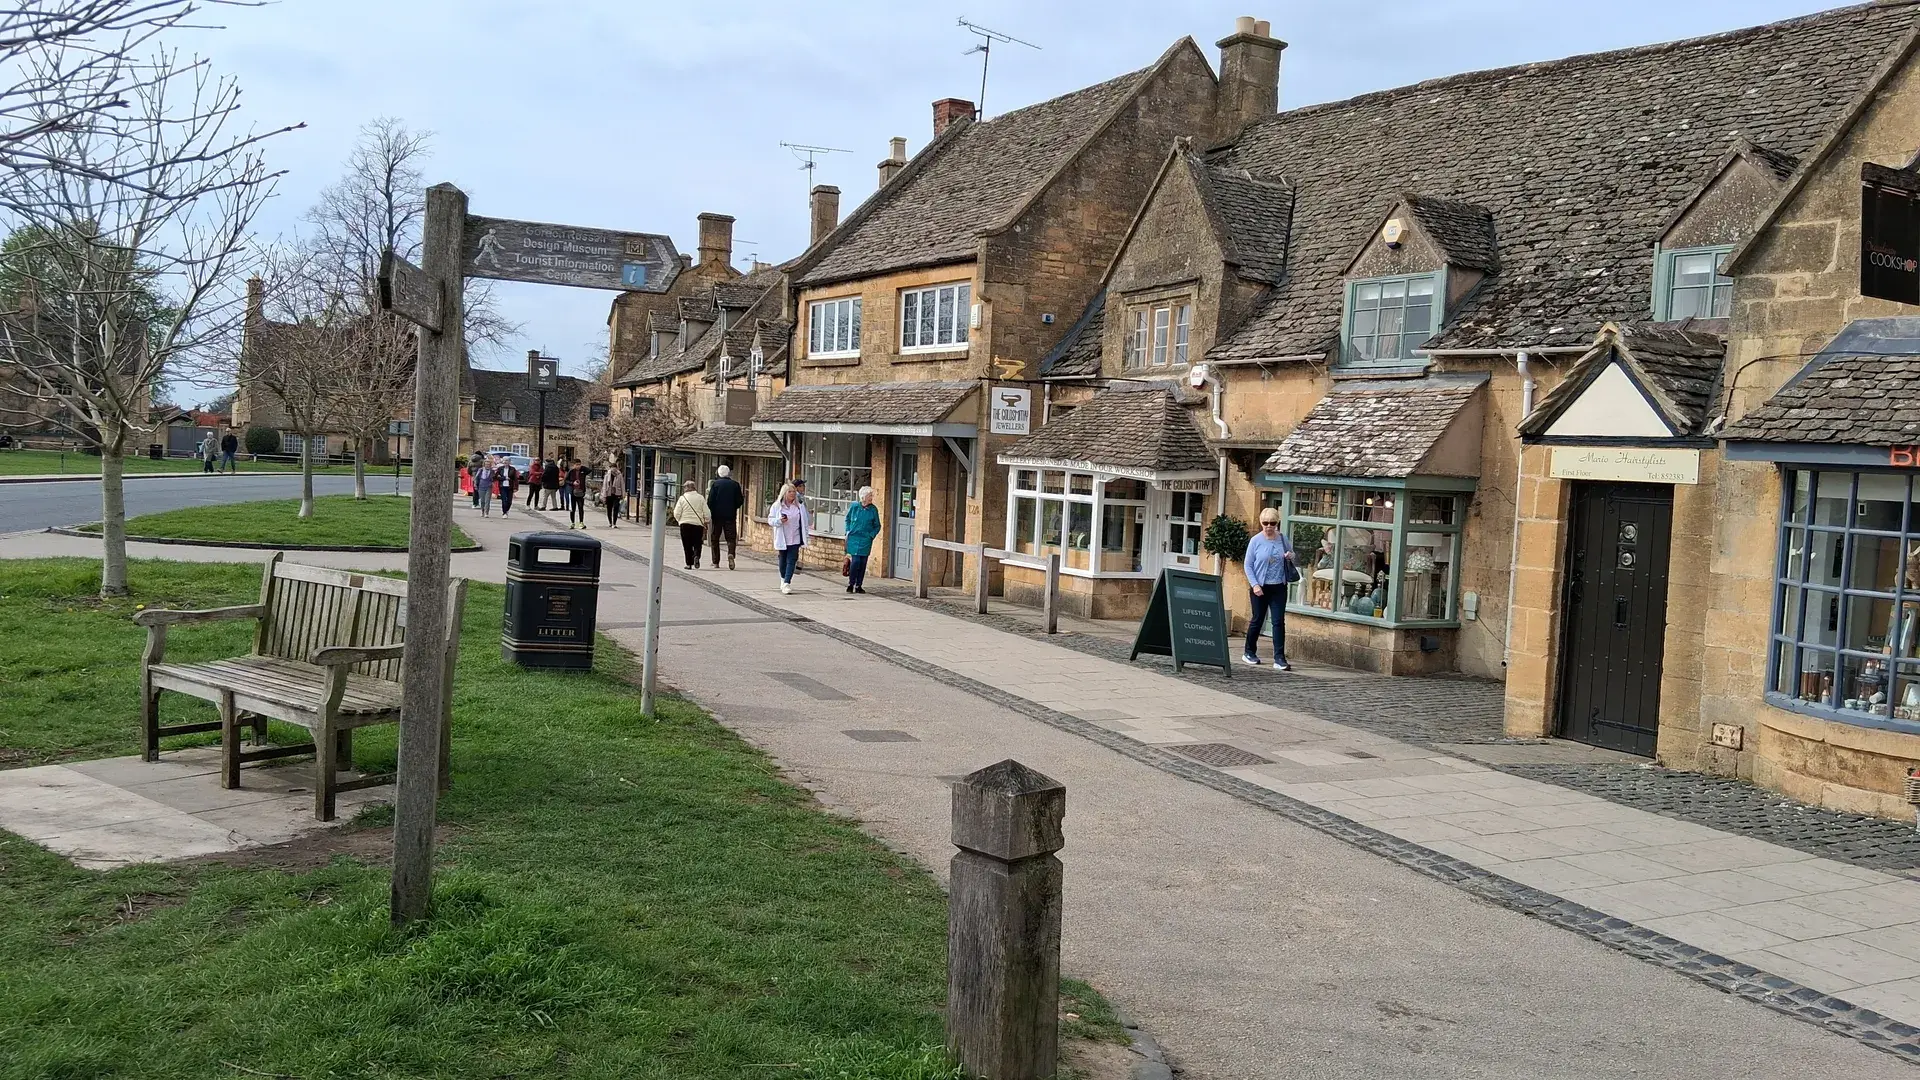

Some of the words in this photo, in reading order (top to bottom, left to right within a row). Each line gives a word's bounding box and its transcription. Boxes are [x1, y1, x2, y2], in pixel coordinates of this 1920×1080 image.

[523, 237, 560, 252] Design
[563, 241, 607, 255] Museum
[515, 253, 554, 267] Tourist
[555, 257, 614, 272] Information
[1870, 251, 1917, 273] COOKSHOP
[546, 268, 581, 281] Centre
[995, 421, 1024, 430] JEWELLERS
[1615, 452, 1666, 469] Hairstylists
[1032, 457, 1061, 466] DESIGNED
[1063, 459, 1069, 467] &
[1071, 460, 1089, 469] MADE
[1090, 462, 1098, 470] IN
[1098, 463, 1113, 473] OUR
[1114, 465, 1154, 478] WORKSHOP
[1562, 469, 1575, 477] First
[1576, 469, 1592, 477] Floor
[1648, 472, 1659, 480] Tel:
[1161, 479, 1172, 490] THE
[1173, 479, 1210, 491] GOLDSMITHY
[1182, 609, 1211, 617] LIFESTYLE
[538, 628, 575, 636] LITTER
[1184, 623, 1213, 631] CLOTHING
[1184, 638, 1215, 646] INTERIORS
